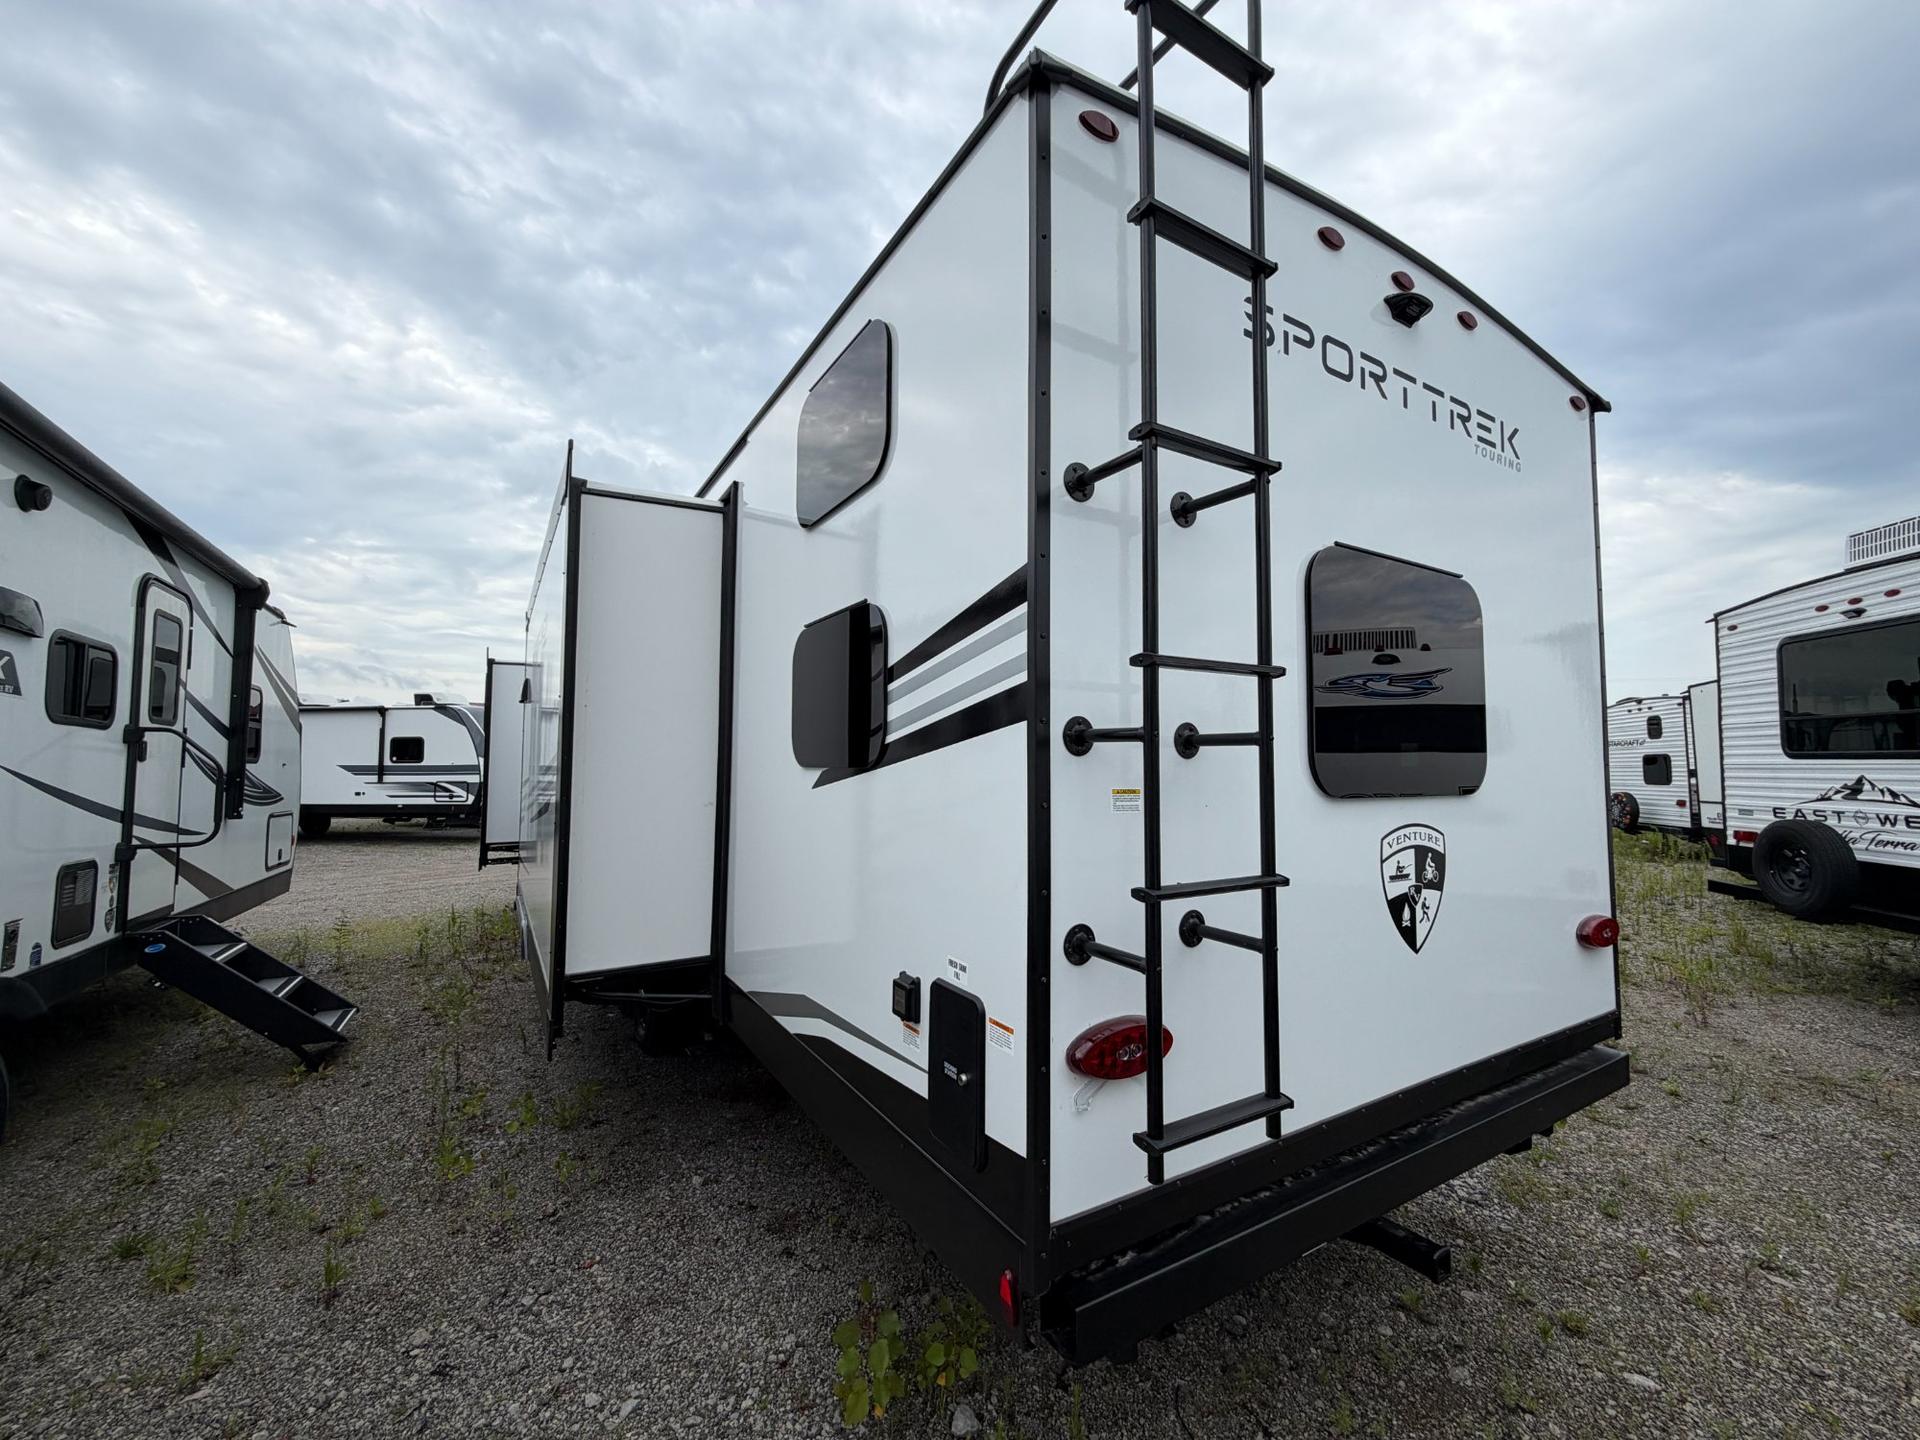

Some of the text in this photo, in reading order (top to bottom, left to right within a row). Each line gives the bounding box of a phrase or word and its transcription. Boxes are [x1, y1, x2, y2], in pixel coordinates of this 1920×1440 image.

[1474, 444, 1521, 472] TOURING
[1772, 807, 1846, 824] EAST
[1387, 832, 1440, 849] VENTURE
[1859, 830, 1920, 852] Terra
